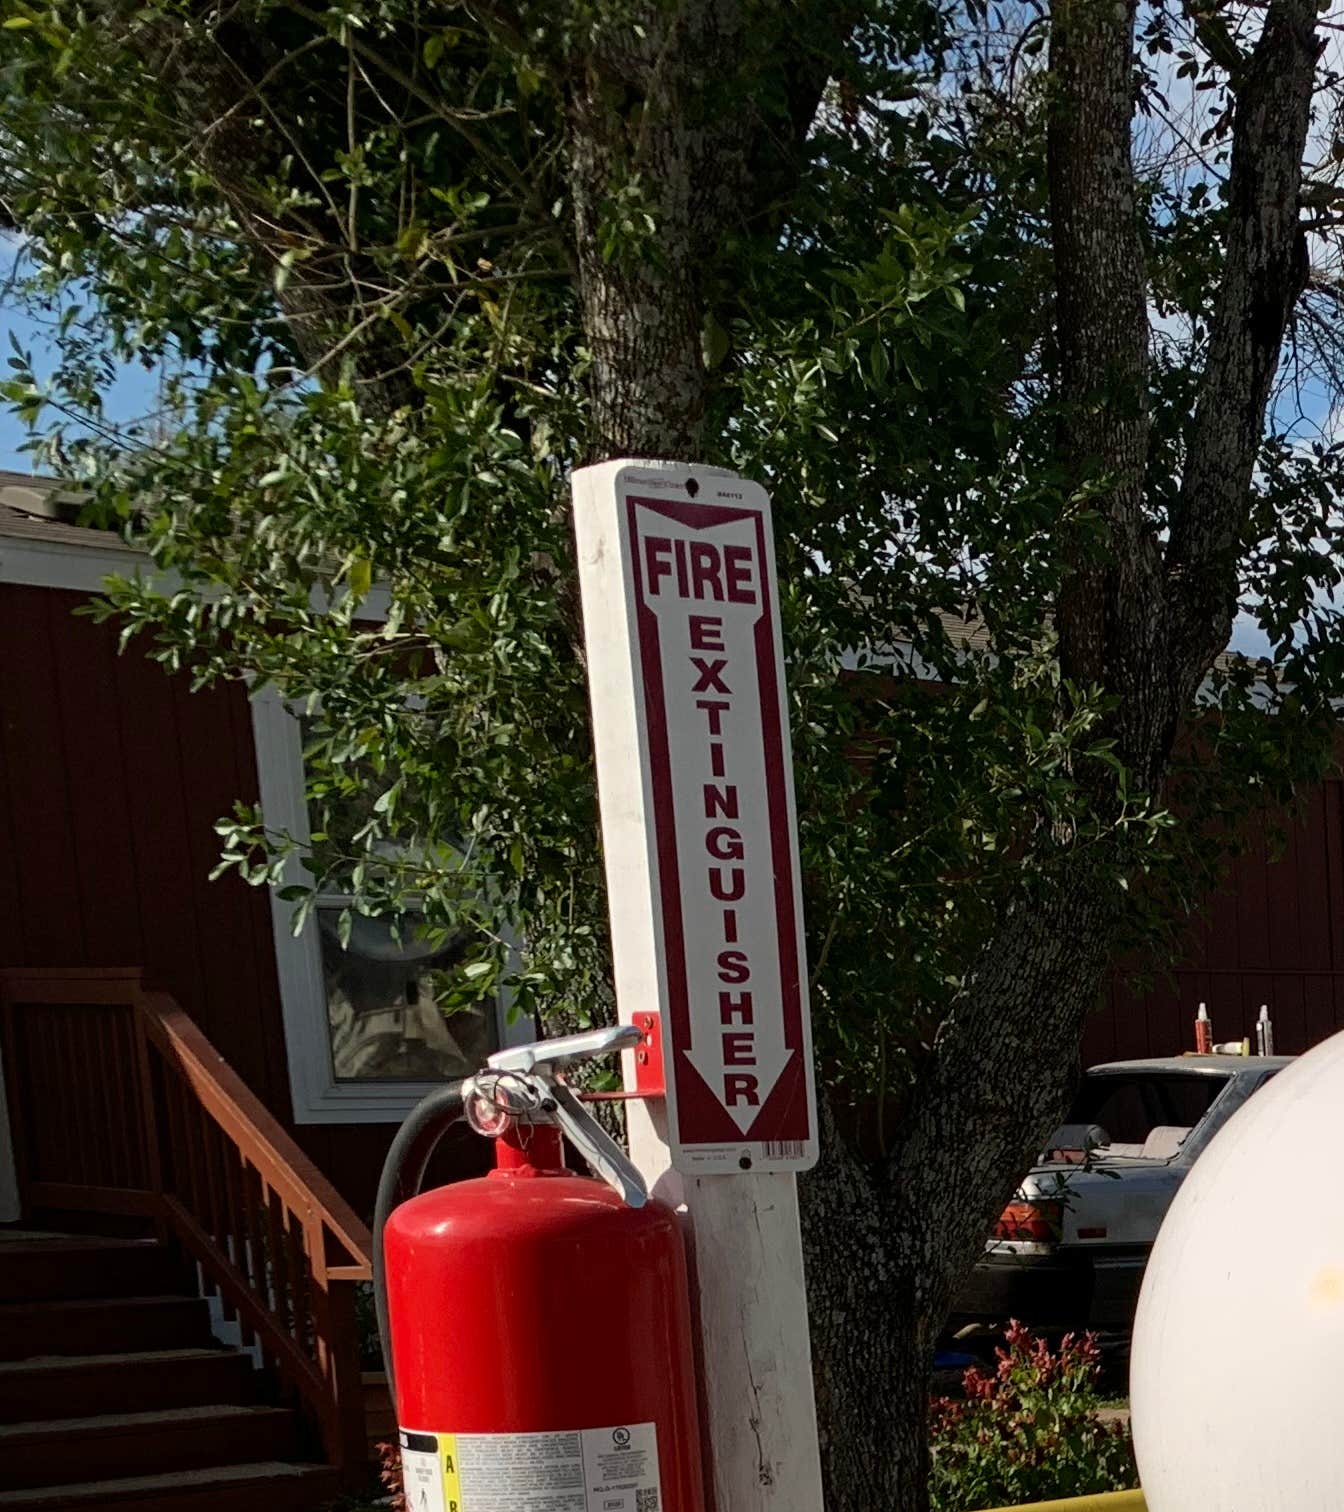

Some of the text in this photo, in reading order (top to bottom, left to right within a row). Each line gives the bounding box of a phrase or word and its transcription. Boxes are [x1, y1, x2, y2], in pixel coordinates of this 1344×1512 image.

[644, 535, 757, 605] FIRE
[687, 614, 760, 1107] EXTINGUISHER
[446, 1455, 455, 1474] A
